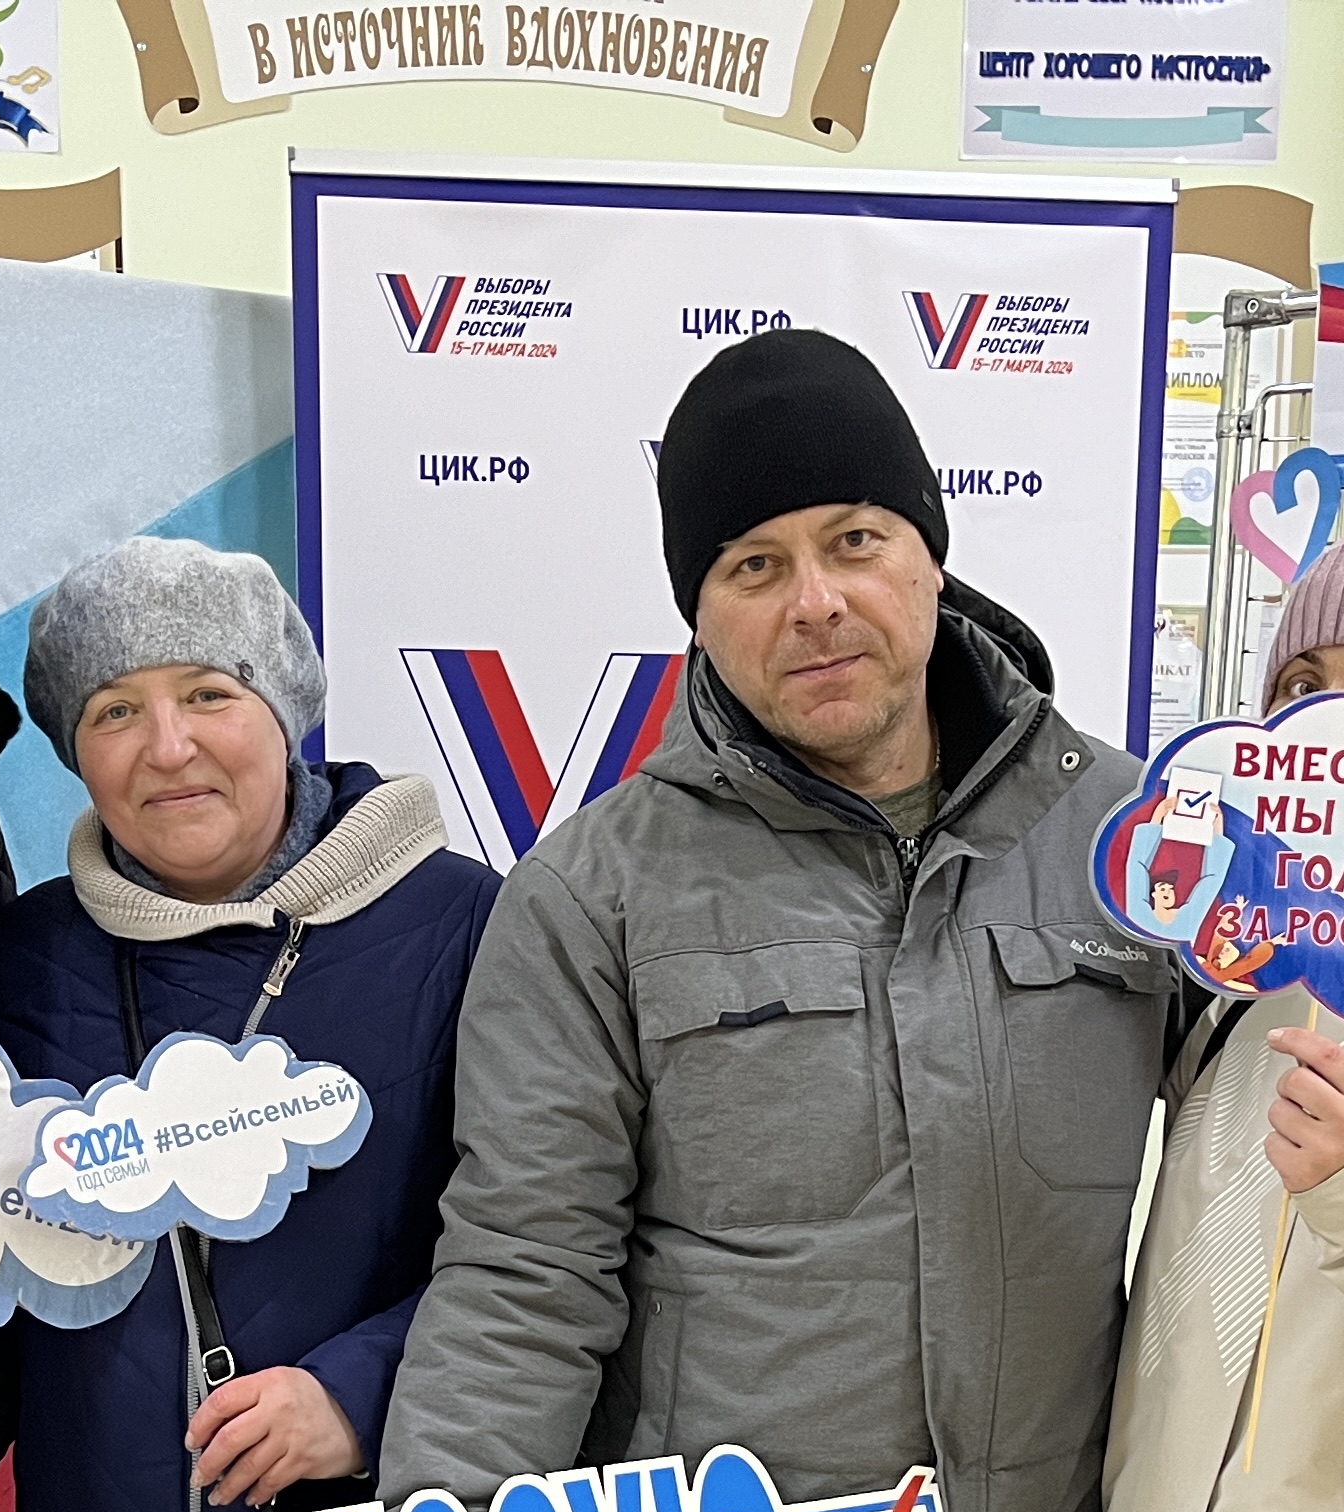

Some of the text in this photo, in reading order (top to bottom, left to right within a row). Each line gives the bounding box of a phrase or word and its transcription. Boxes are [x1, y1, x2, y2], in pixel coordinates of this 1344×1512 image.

[248, 3, 770, 98] В ИСТОЧНИК ВДОХНОВЕНИЯ
[979, 51, 1034, 77] ЦЕНТР
[1043, 52, 1142, 79] ХОРОШЕГО
[474, 278, 551, 296] ВЫБОРЫ
[465, 299, 572, 319] ПРЕЗИДЕНТА
[996, 295, 1070, 313] ВЫБОРЫ
[456, 320, 526, 338] РОССИИ
[682, 308, 792, 340] ЦИК.РФ
[986, 316, 1090, 336] ПРЕЗИДЕНТА
[484, 342, 526, 357] МАРТА
[527, 343, 558, 358] 2024
[977, 337, 1044, 355] РОССИИ
[1005, 360, 1044, 374] МАРТА
[1045, 360, 1074, 375] 2024
[419, 454, 530, 486] ЦИК.РФ
[1254, 796, 1335, 836] МЫ
[1215, 905, 1271, 942] ЗА
[154, 1077, 355, 1153] #Всейсемьёй
[67, 1118, 144, 1171] 2024
